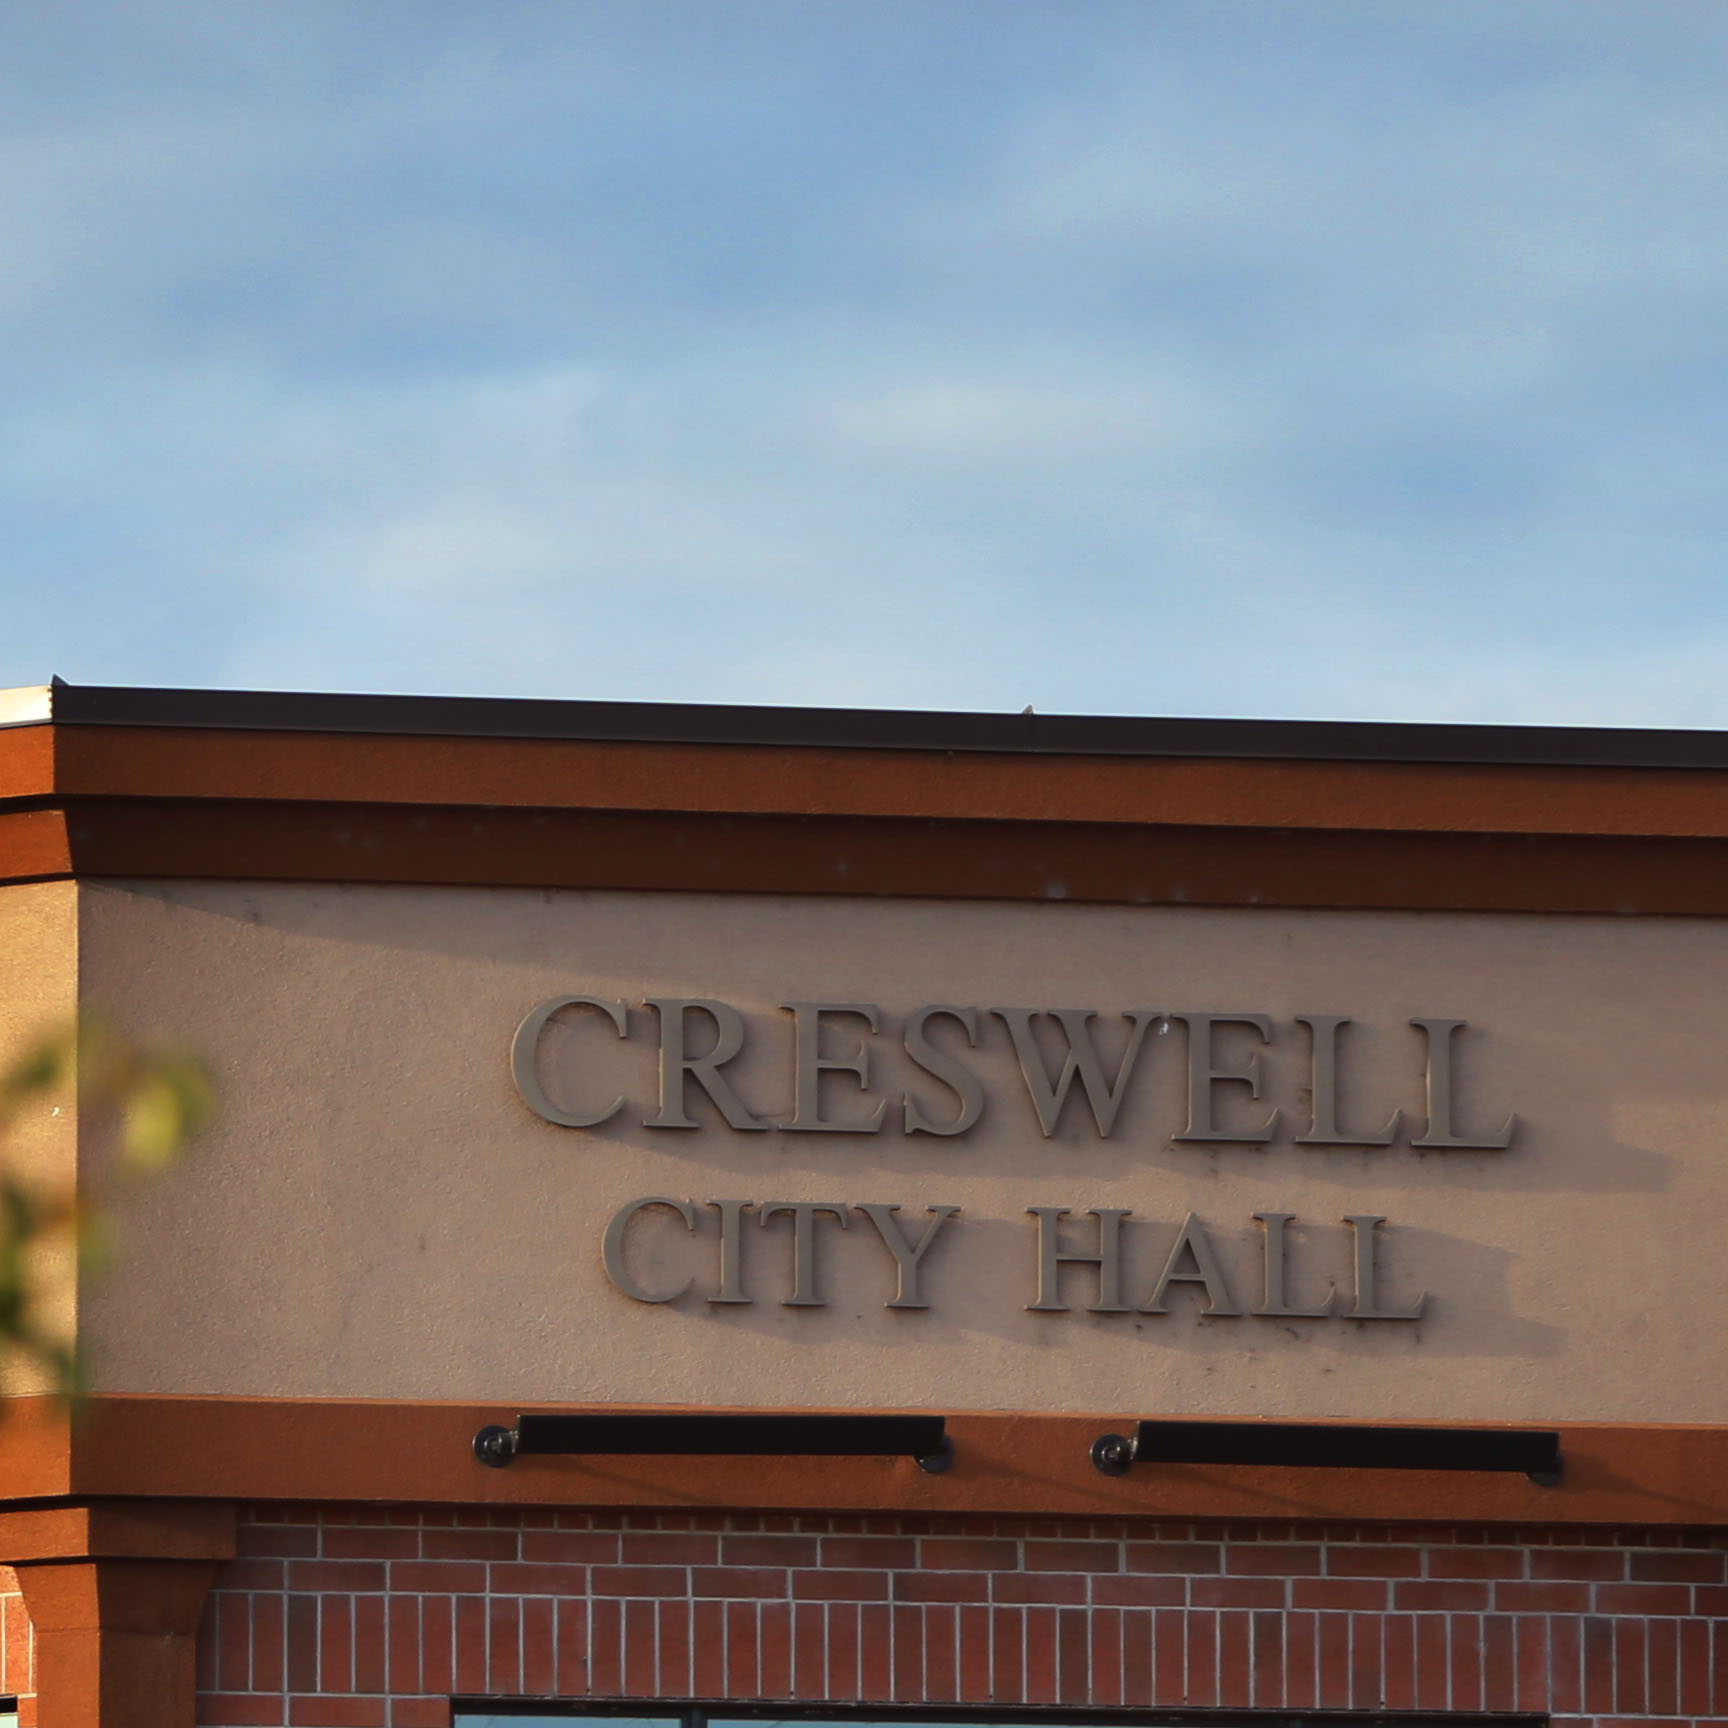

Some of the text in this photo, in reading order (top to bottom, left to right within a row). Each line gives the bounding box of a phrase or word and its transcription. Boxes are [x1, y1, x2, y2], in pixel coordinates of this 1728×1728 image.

[510, 994, 1519, 1149] CRESWELL
[601, 1196, 1428, 1320] CITY HALL
